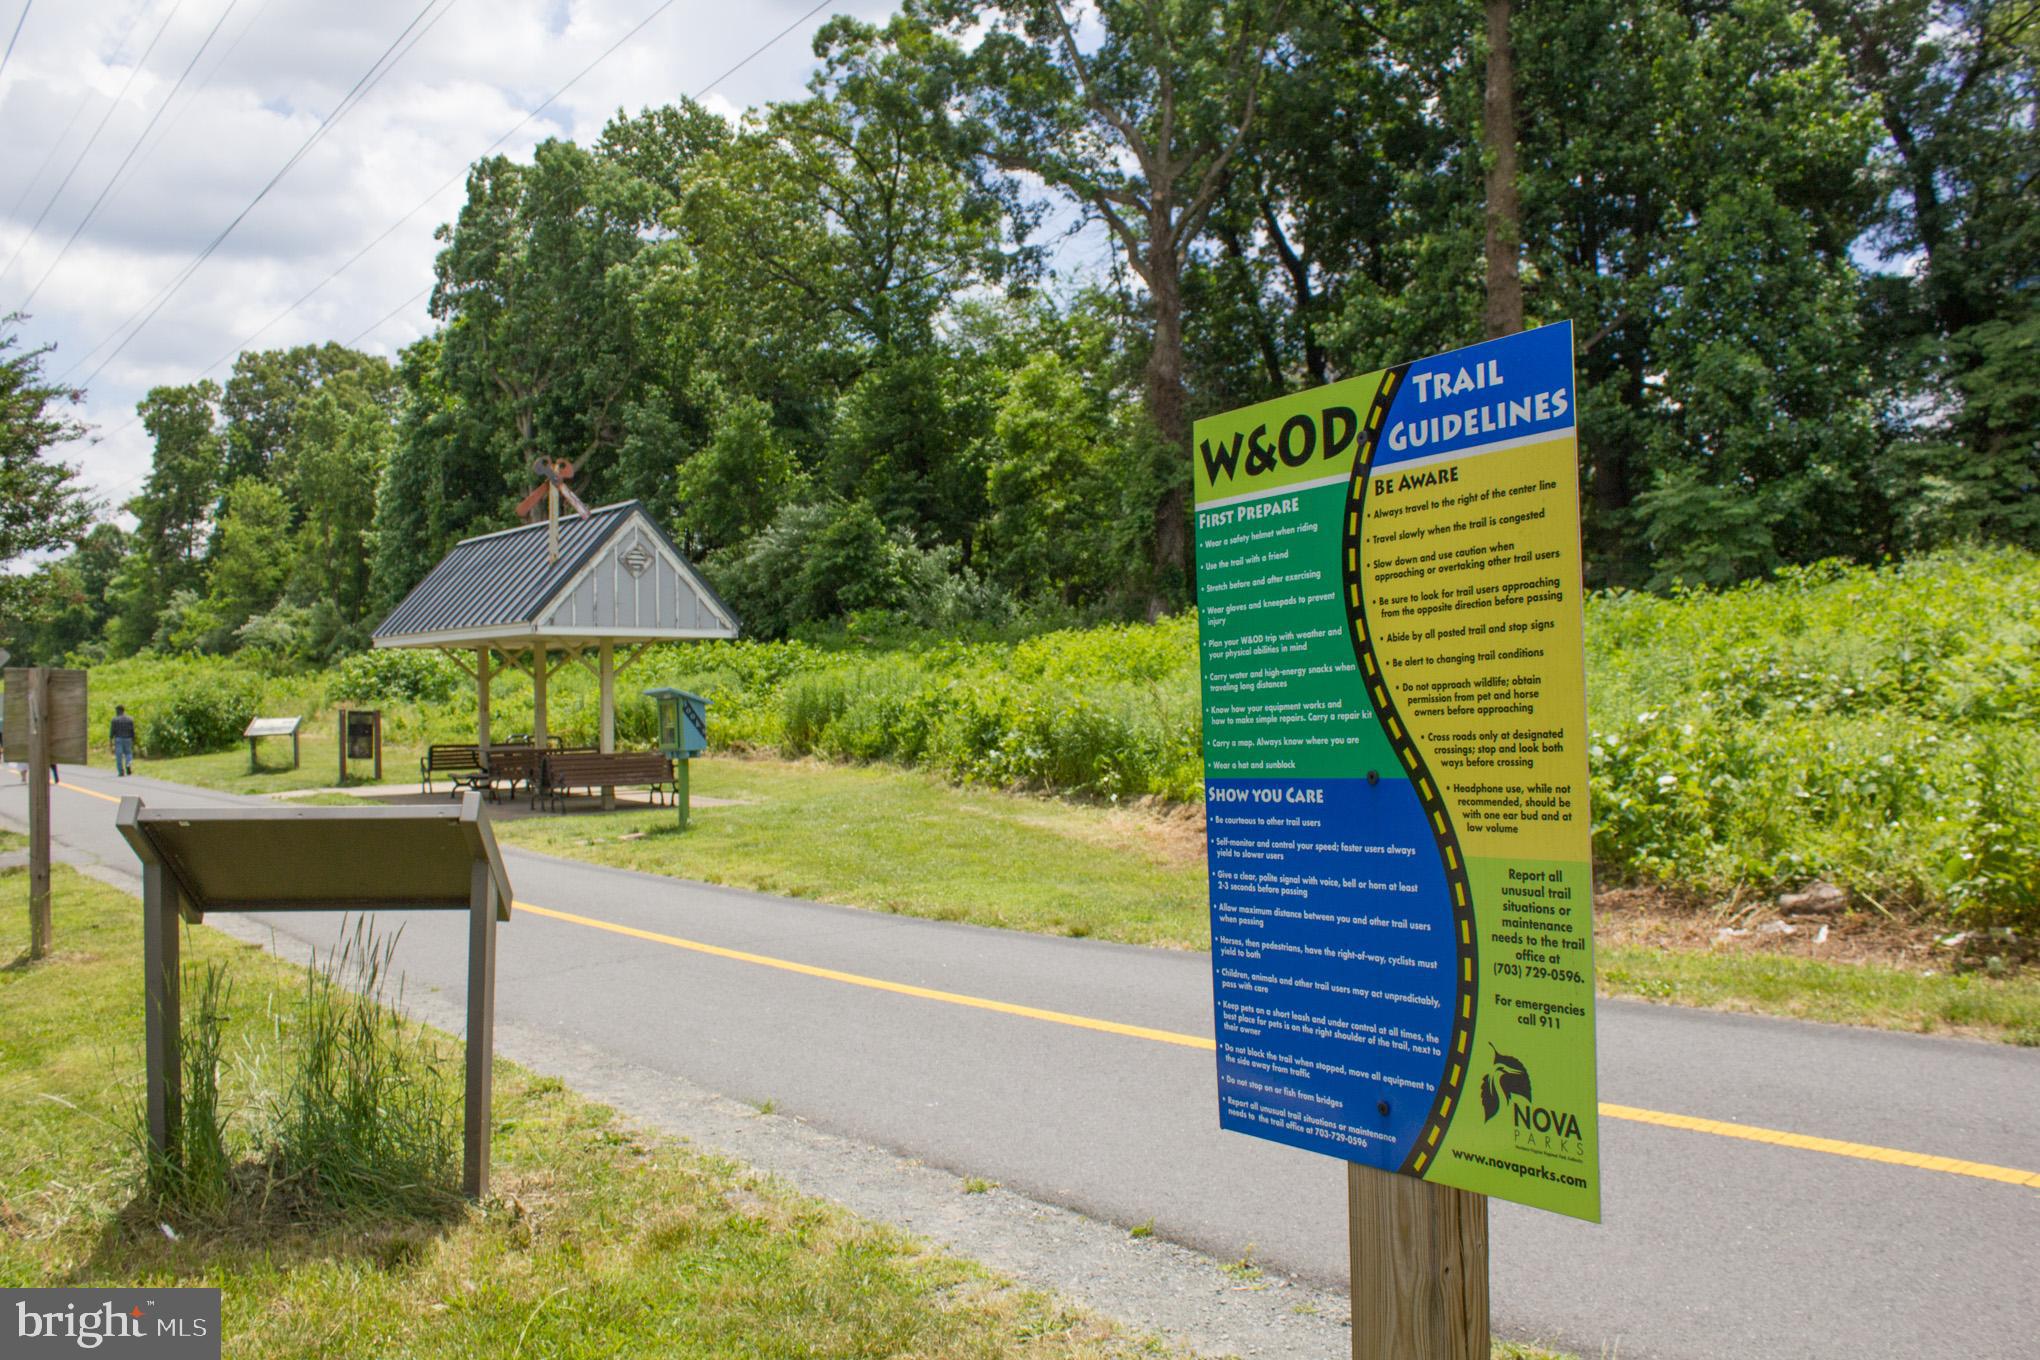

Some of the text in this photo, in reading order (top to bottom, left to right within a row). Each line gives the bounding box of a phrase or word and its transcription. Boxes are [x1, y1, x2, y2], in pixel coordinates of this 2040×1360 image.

[1412, 359, 1504, 403] TRAIL
[1388, 388, 1568, 451] GUIDELINES
[1199, 405, 1358, 487] W&OD
[1375, 466, 1458, 496] BE AWARE
[1373, 480, 1557, 519] Always travel to the right of the center line
[1199, 497, 1299, 529] FIRST PREPARE
[1372, 507, 1545, 544] Travel slowly when the trail is congested
[1205, 562, 1218, 571] Use
[1218, 560, 1230, 568] the
[1230, 556, 1244, 567] trail
[1245, 554, 1261, 564] with
[1268, 549, 1289, 561] friend
[1373, 541, 1515, 569] Slow down and use caution when
[1374, 550, 1560, 583] approaching or overtaking other trail users
[1379, 576, 1560, 606] Be sure to look for trail users approaching
[1381, 590, 1563, 618] from the opposite direction before passing
[1207, 617, 1226, 628] injury
[1386, 619, 1555, 643] Abide by all posted trail and stop signs
[1392, 647, 1544, 667] Be alert to changing trail conditions
[1212, 739, 1230, 749] Carry
[1237, 740, 1255, 749] map.
[1256, 737, 1282, 748] Always
[1283, 736, 1304, 746] know
[1305, 736, 1329, 745] where
[1330, 737, 1345, 746] you
[1427, 728, 1564, 743] Cross roads only at designated
[1213, 761, 1231, 769] Wear
[1237, 760, 1249, 769] hat
[1250, 760, 1264, 769] and
[1265, 760, 1296, 769] sunblock
[1208, 786, 1324, 804] SHOW YOU CARE
[1453, 783, 1571, 796] Headphone use, while not
[1457, 796, 1571, 808] recommended, should be
[1215, 815, 1224, 824] Be
[1224, 817, 1257, 825] courteous
[1257, 817, 1265, 825] to
[1266, 816, 1285, 826] other
[1285, 817, 1301, 826] trail
[1466, 822, 1519, 834] low volume
[1216, 848, 1233, 858] yield
[1233, 850, 1241, 858] to
[1242, 849, 1265, 859] slower
[1508, 868, 1562, 884] Report all
[1218, 881, 1308, 899] 2-3 seconds before passing
[1501, 885, 1571, 900] unusual trail
[1502, 900, 1572, 916] situations or
[1219, 914, 1264, 928] when passing
[1502, 916, 1573, 933] maintenance
[1491, 931, 1585, 951] needs to the trail
[1515, 948, 1561, 964] office at
[1493, 962, 1585, 984] (703) 729-0596.
[1495, 993, 1585, 1017] For emergencies
[1223, 1022, 1261, 1036] their owner
[1517, 1013, 1560, 1029] call 911
[1228, 1108, 1368, 1148] needs to the trail office at 703-729-0596
[1514, 1102, 1582, 1140] NOVA
[1515, 1129, 1584, 1155] PARKS
[1452, 1149, 1587, 1189] www.novaparks.com
